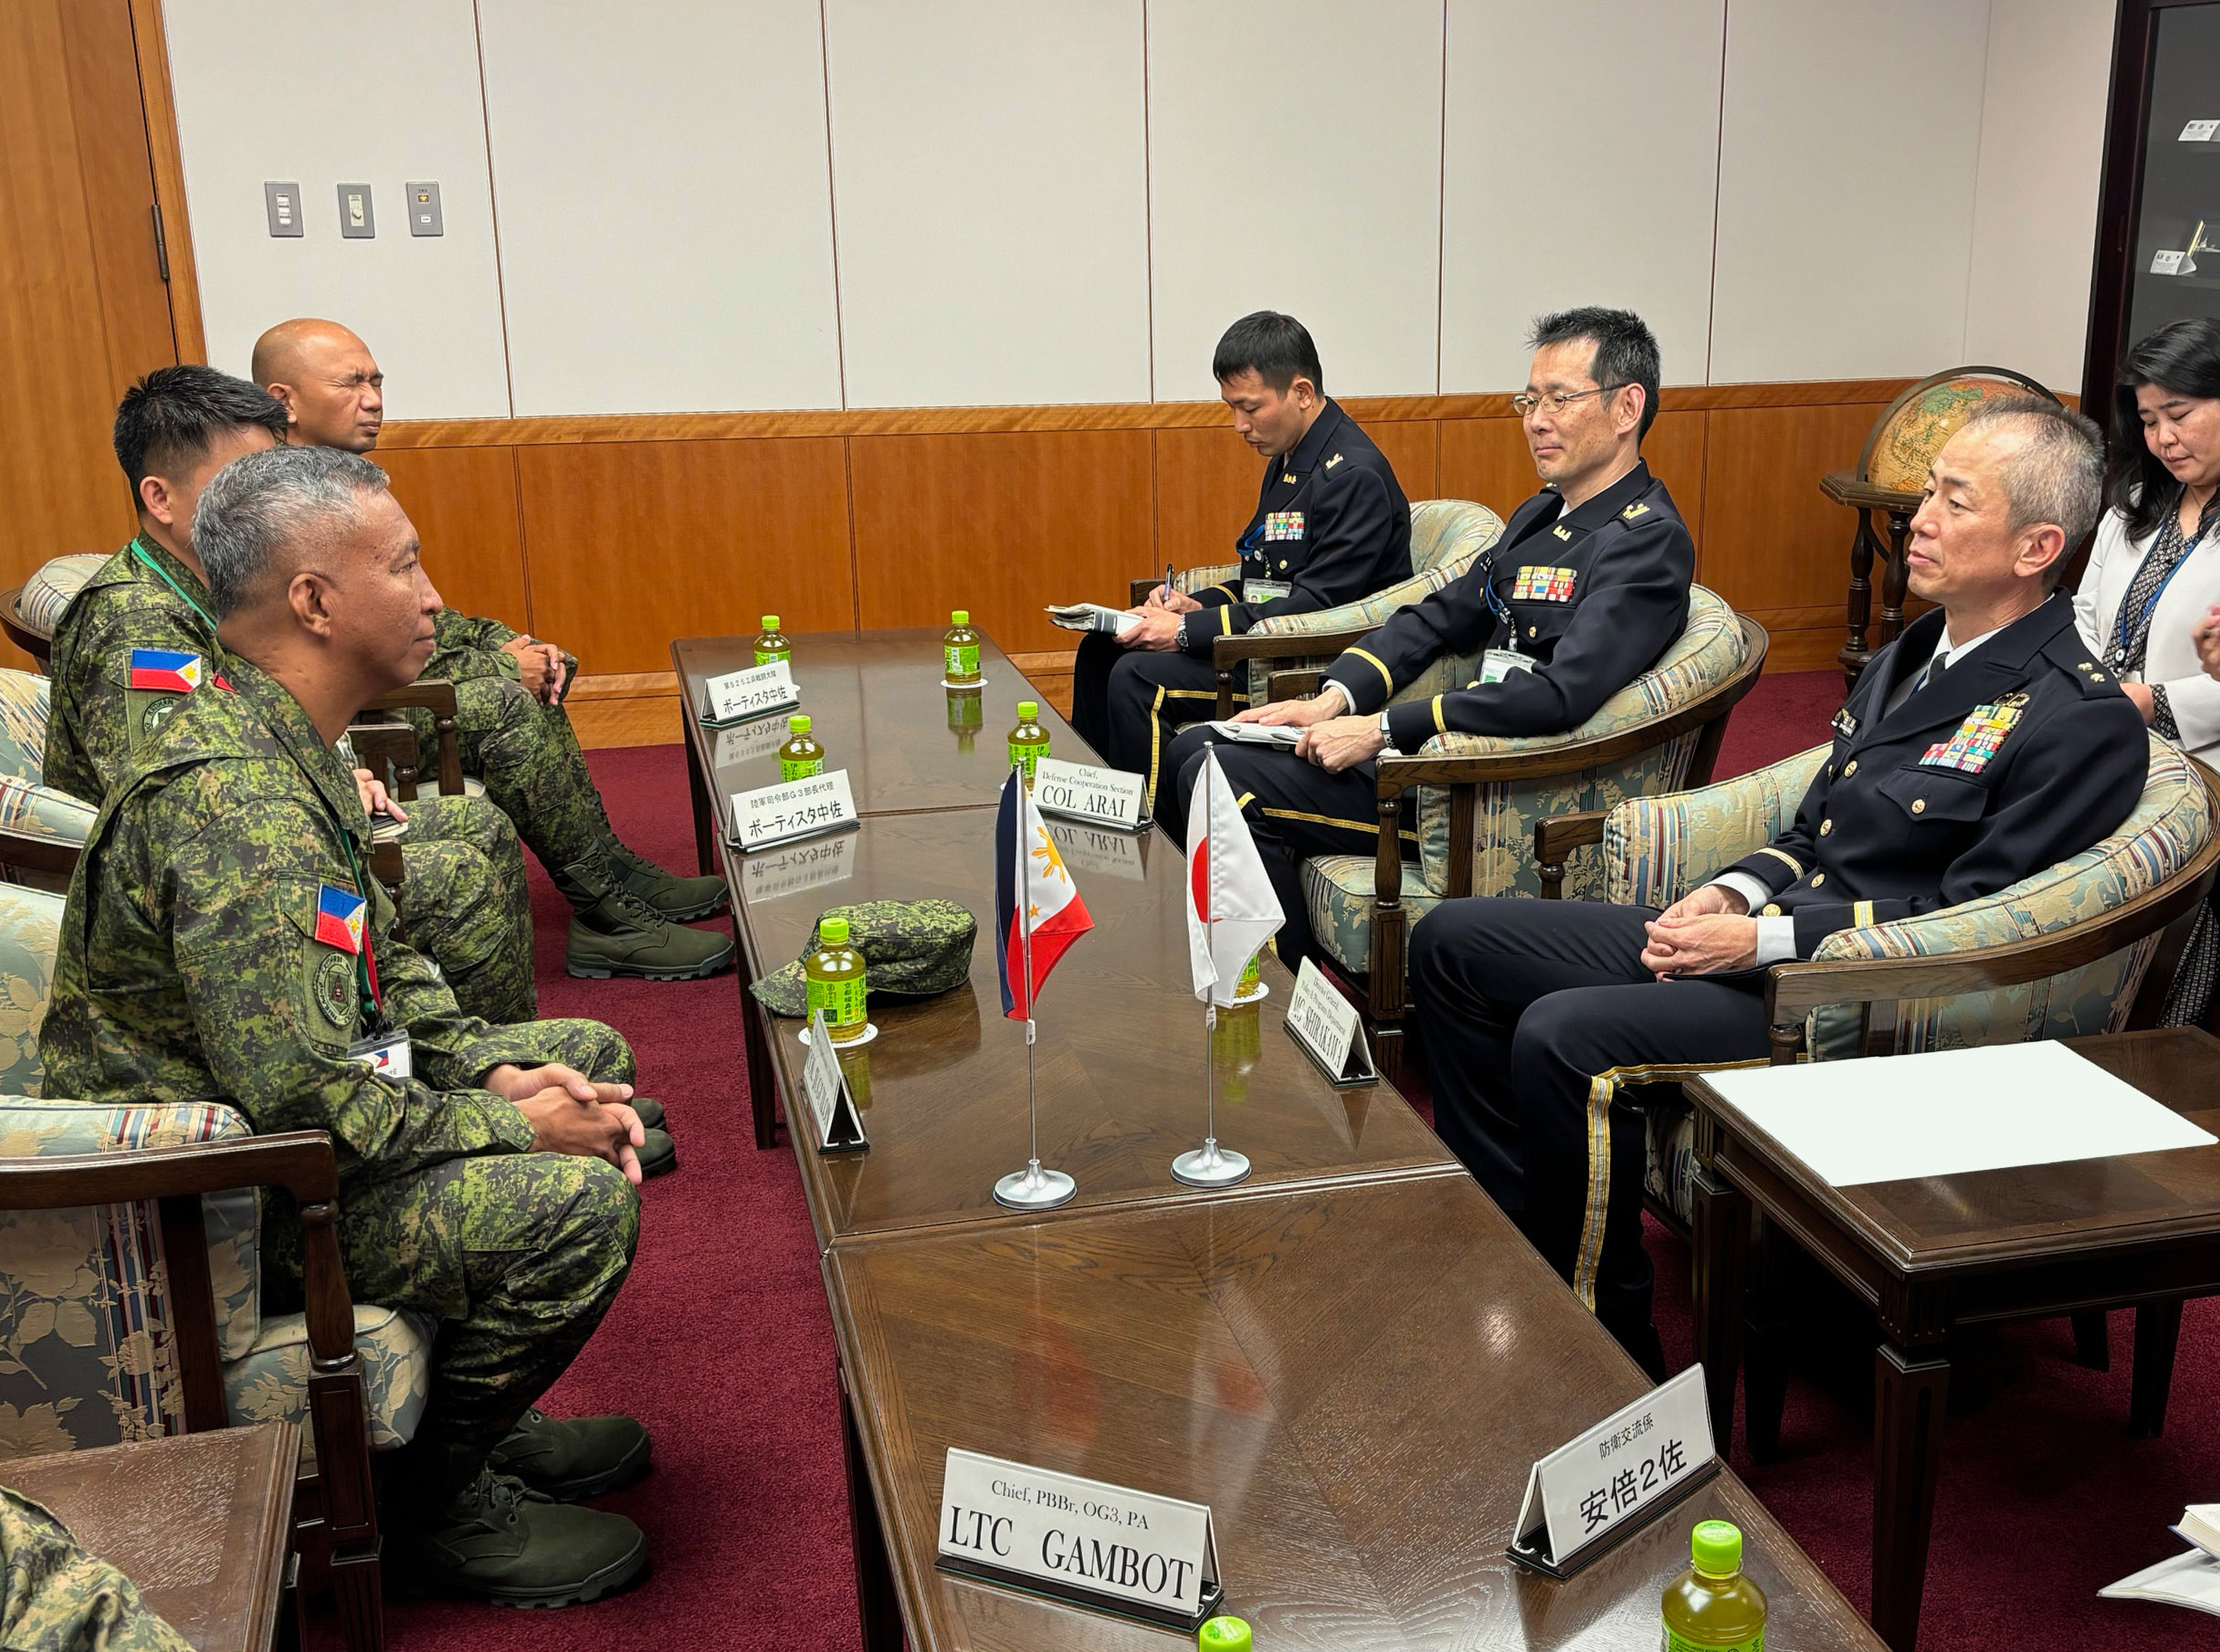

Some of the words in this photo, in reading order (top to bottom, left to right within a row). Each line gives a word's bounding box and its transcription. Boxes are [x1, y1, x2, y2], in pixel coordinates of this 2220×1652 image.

[1042, 771, 1068, 784] Defense
[1068, 776, 1108, 791] Cooperation
[1110, 784, 1133, 795] Section
[1078, 768, 1098, 780] Chief,
[749, 800, 844, 838] ボーティスタ中佐
[1042, 784, 1077, 809] COL
[1084, 793, 1126, 817] ARAI
[1303, 1005, 1342, 1068] SHIRAKAWA
[1599, 1412, 1655, 1461] 防衛交流係
[991, 1479, 1032, 1504] Chief,
[1036, 1489, 1078, 1514] PBBr,
[1084, 1500, 1122, 1526] OG3,
[1128, 1510, 1149, 1531] PA
[1580, 1438, 1688, 1534] 安倍2佐
[948, 1506, 1014, 1557] LTC
[1041, 1528, 1194, 1600] GAMBOT
